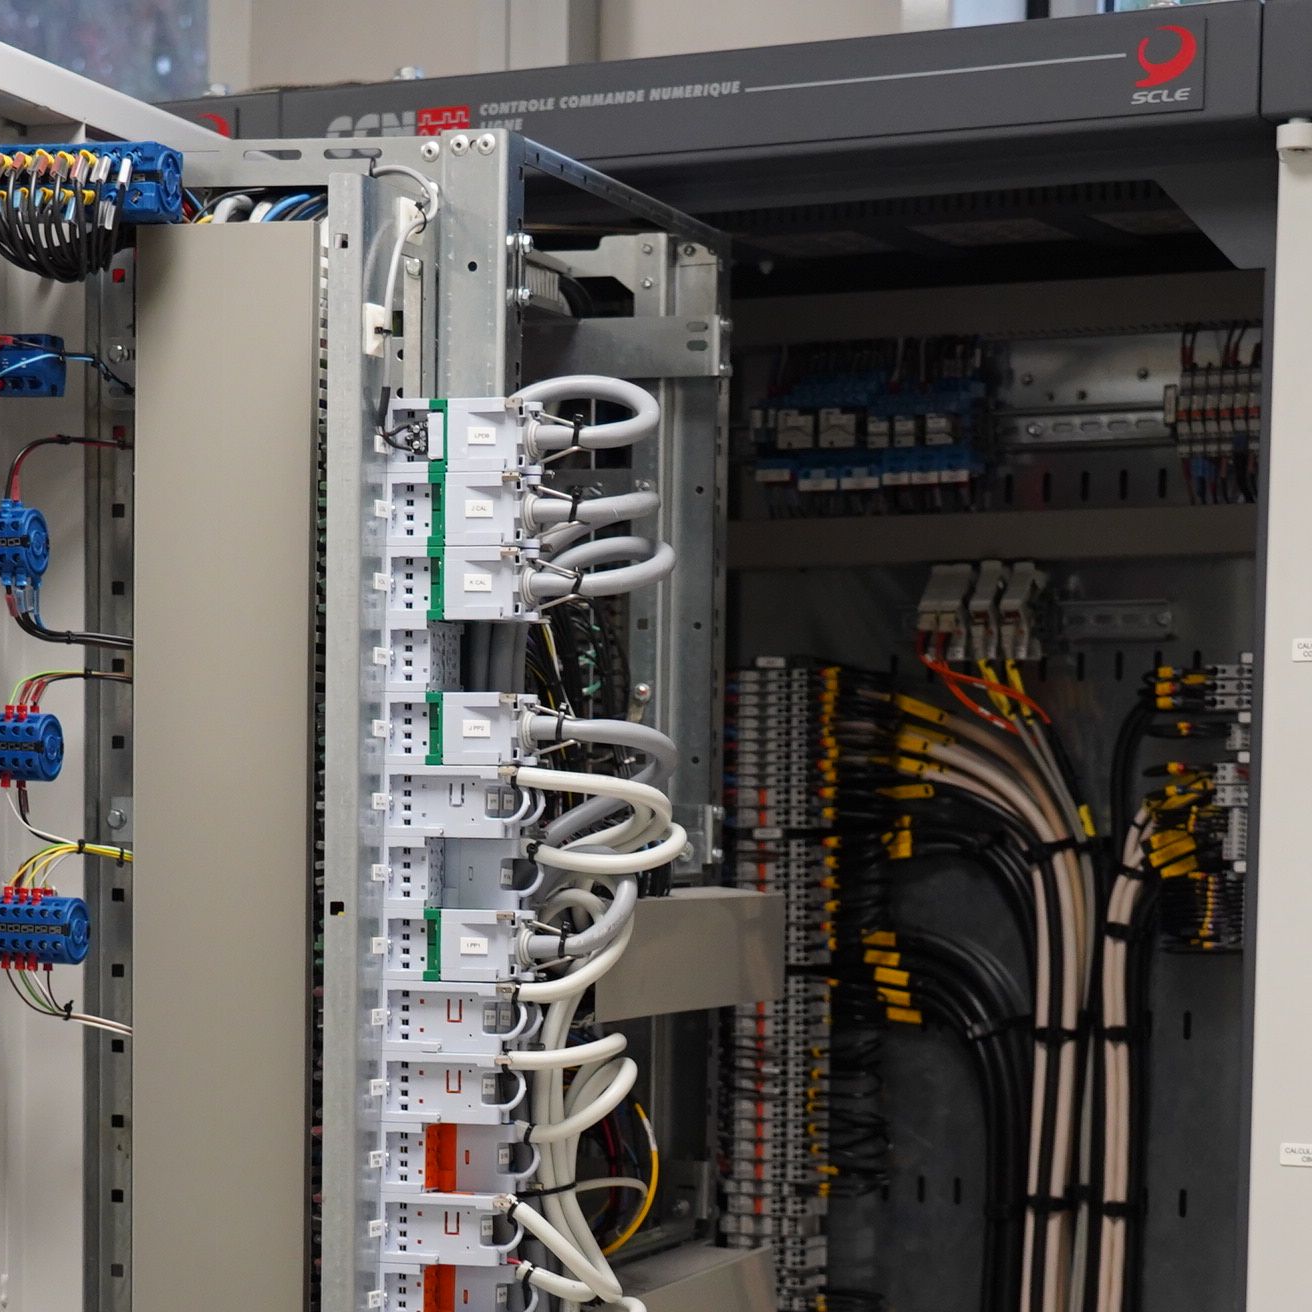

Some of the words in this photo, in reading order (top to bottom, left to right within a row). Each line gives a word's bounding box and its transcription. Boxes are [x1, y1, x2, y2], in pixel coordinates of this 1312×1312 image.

[479, 98, 555, 117] CONTROLE
[559, 90, 645, 110] COMMANDE
[649, 80, 741, 102] NUMERIQUE
[1130, 88, 1192, 105] SCLE
